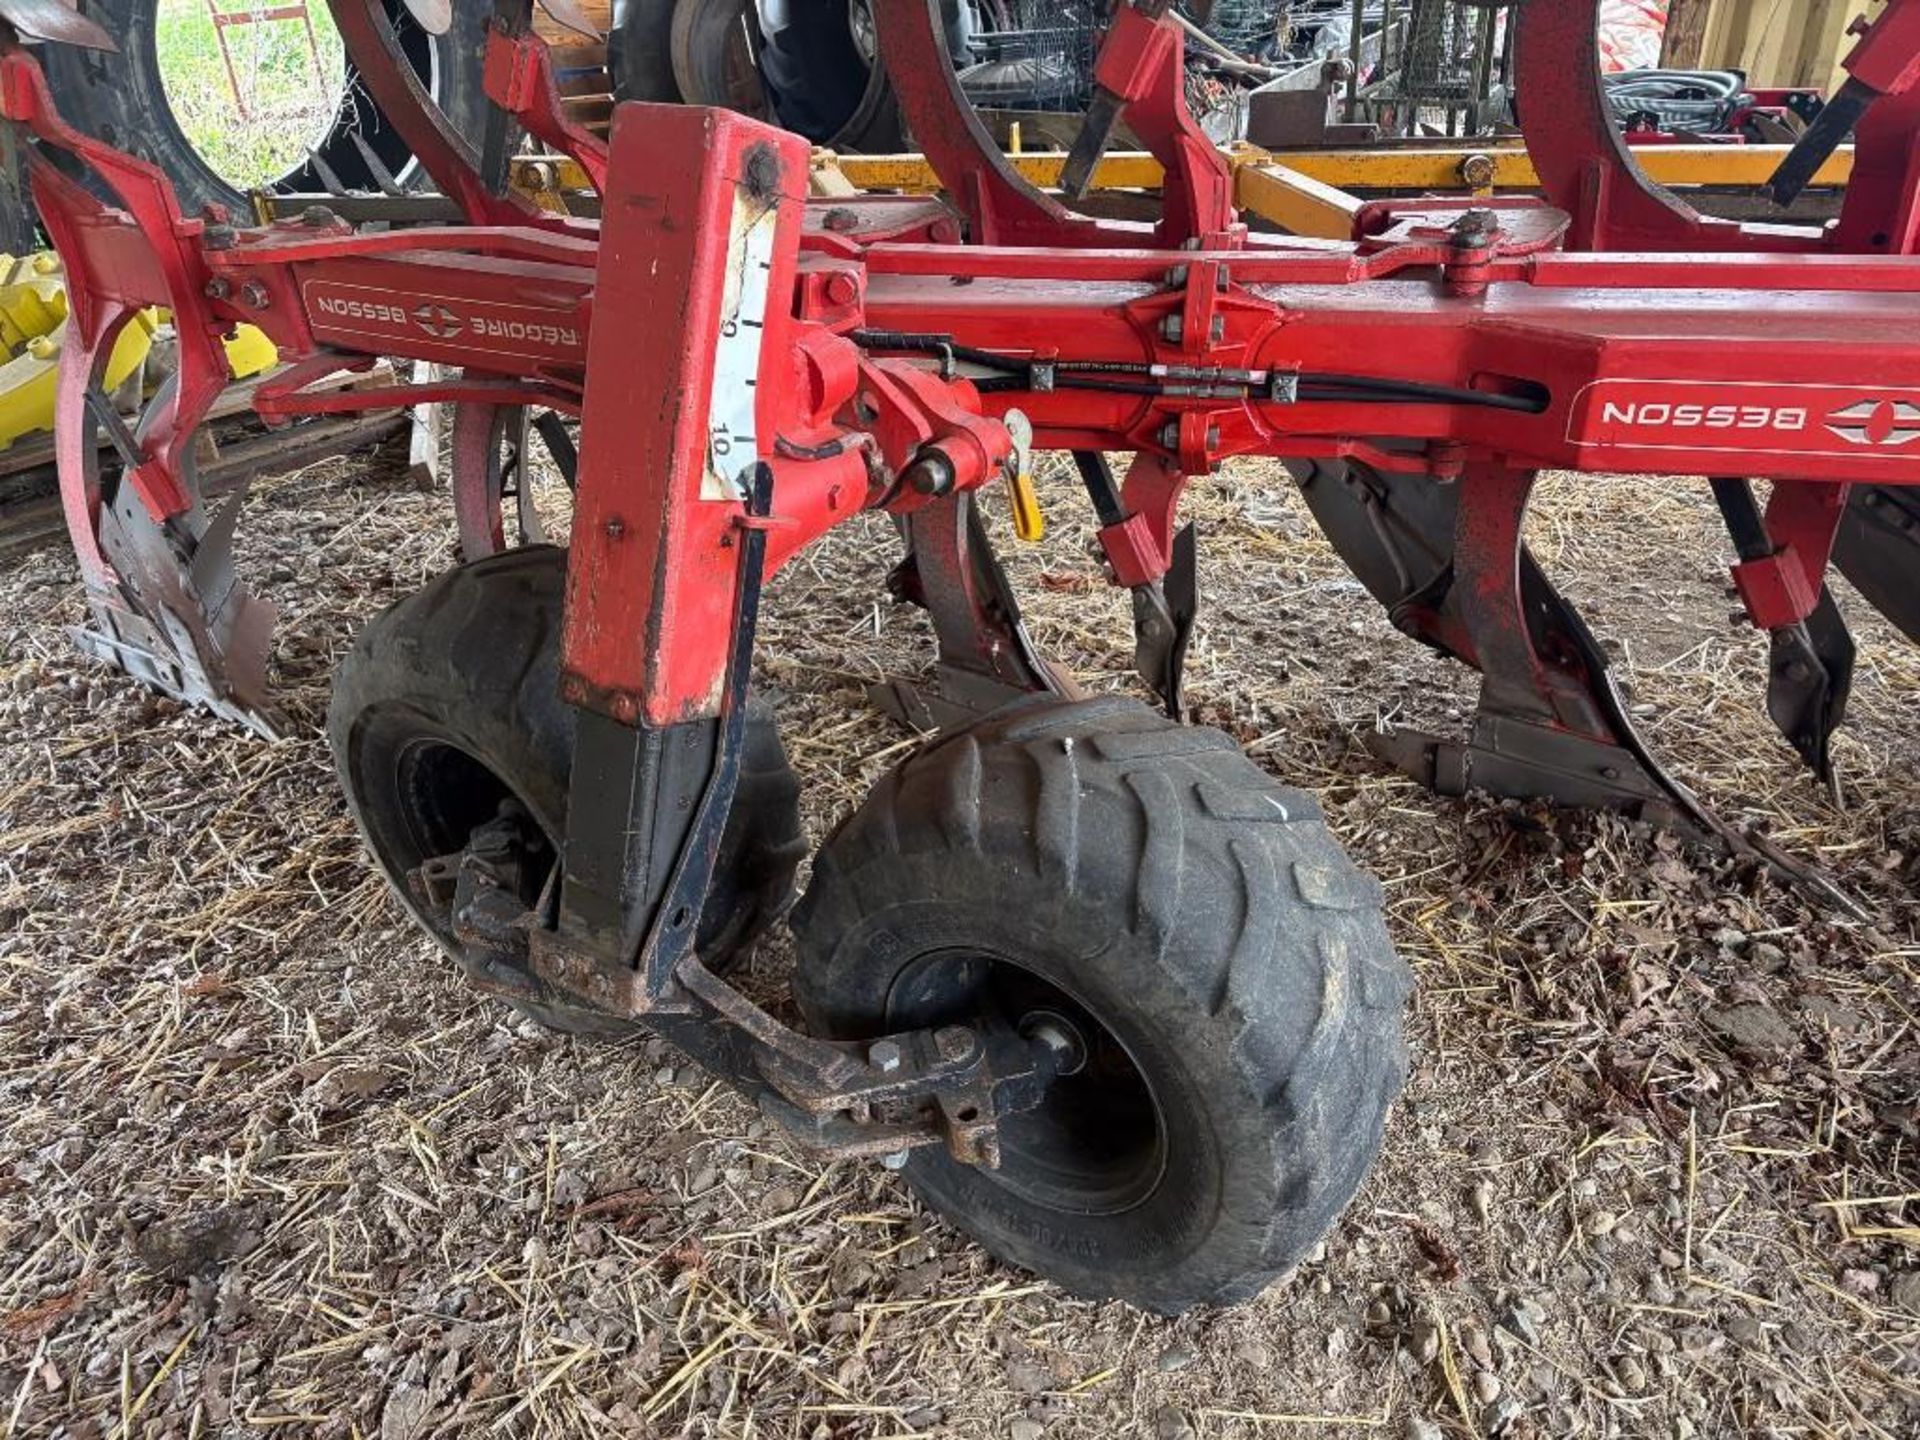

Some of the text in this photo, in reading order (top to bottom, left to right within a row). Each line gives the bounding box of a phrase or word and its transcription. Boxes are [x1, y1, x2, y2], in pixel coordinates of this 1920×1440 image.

[317, 296, 582, 346] RÉGOIRE BESSON
[1602, 401, 1807, 430] BESSON
[713, 422, 732, 457] 10
